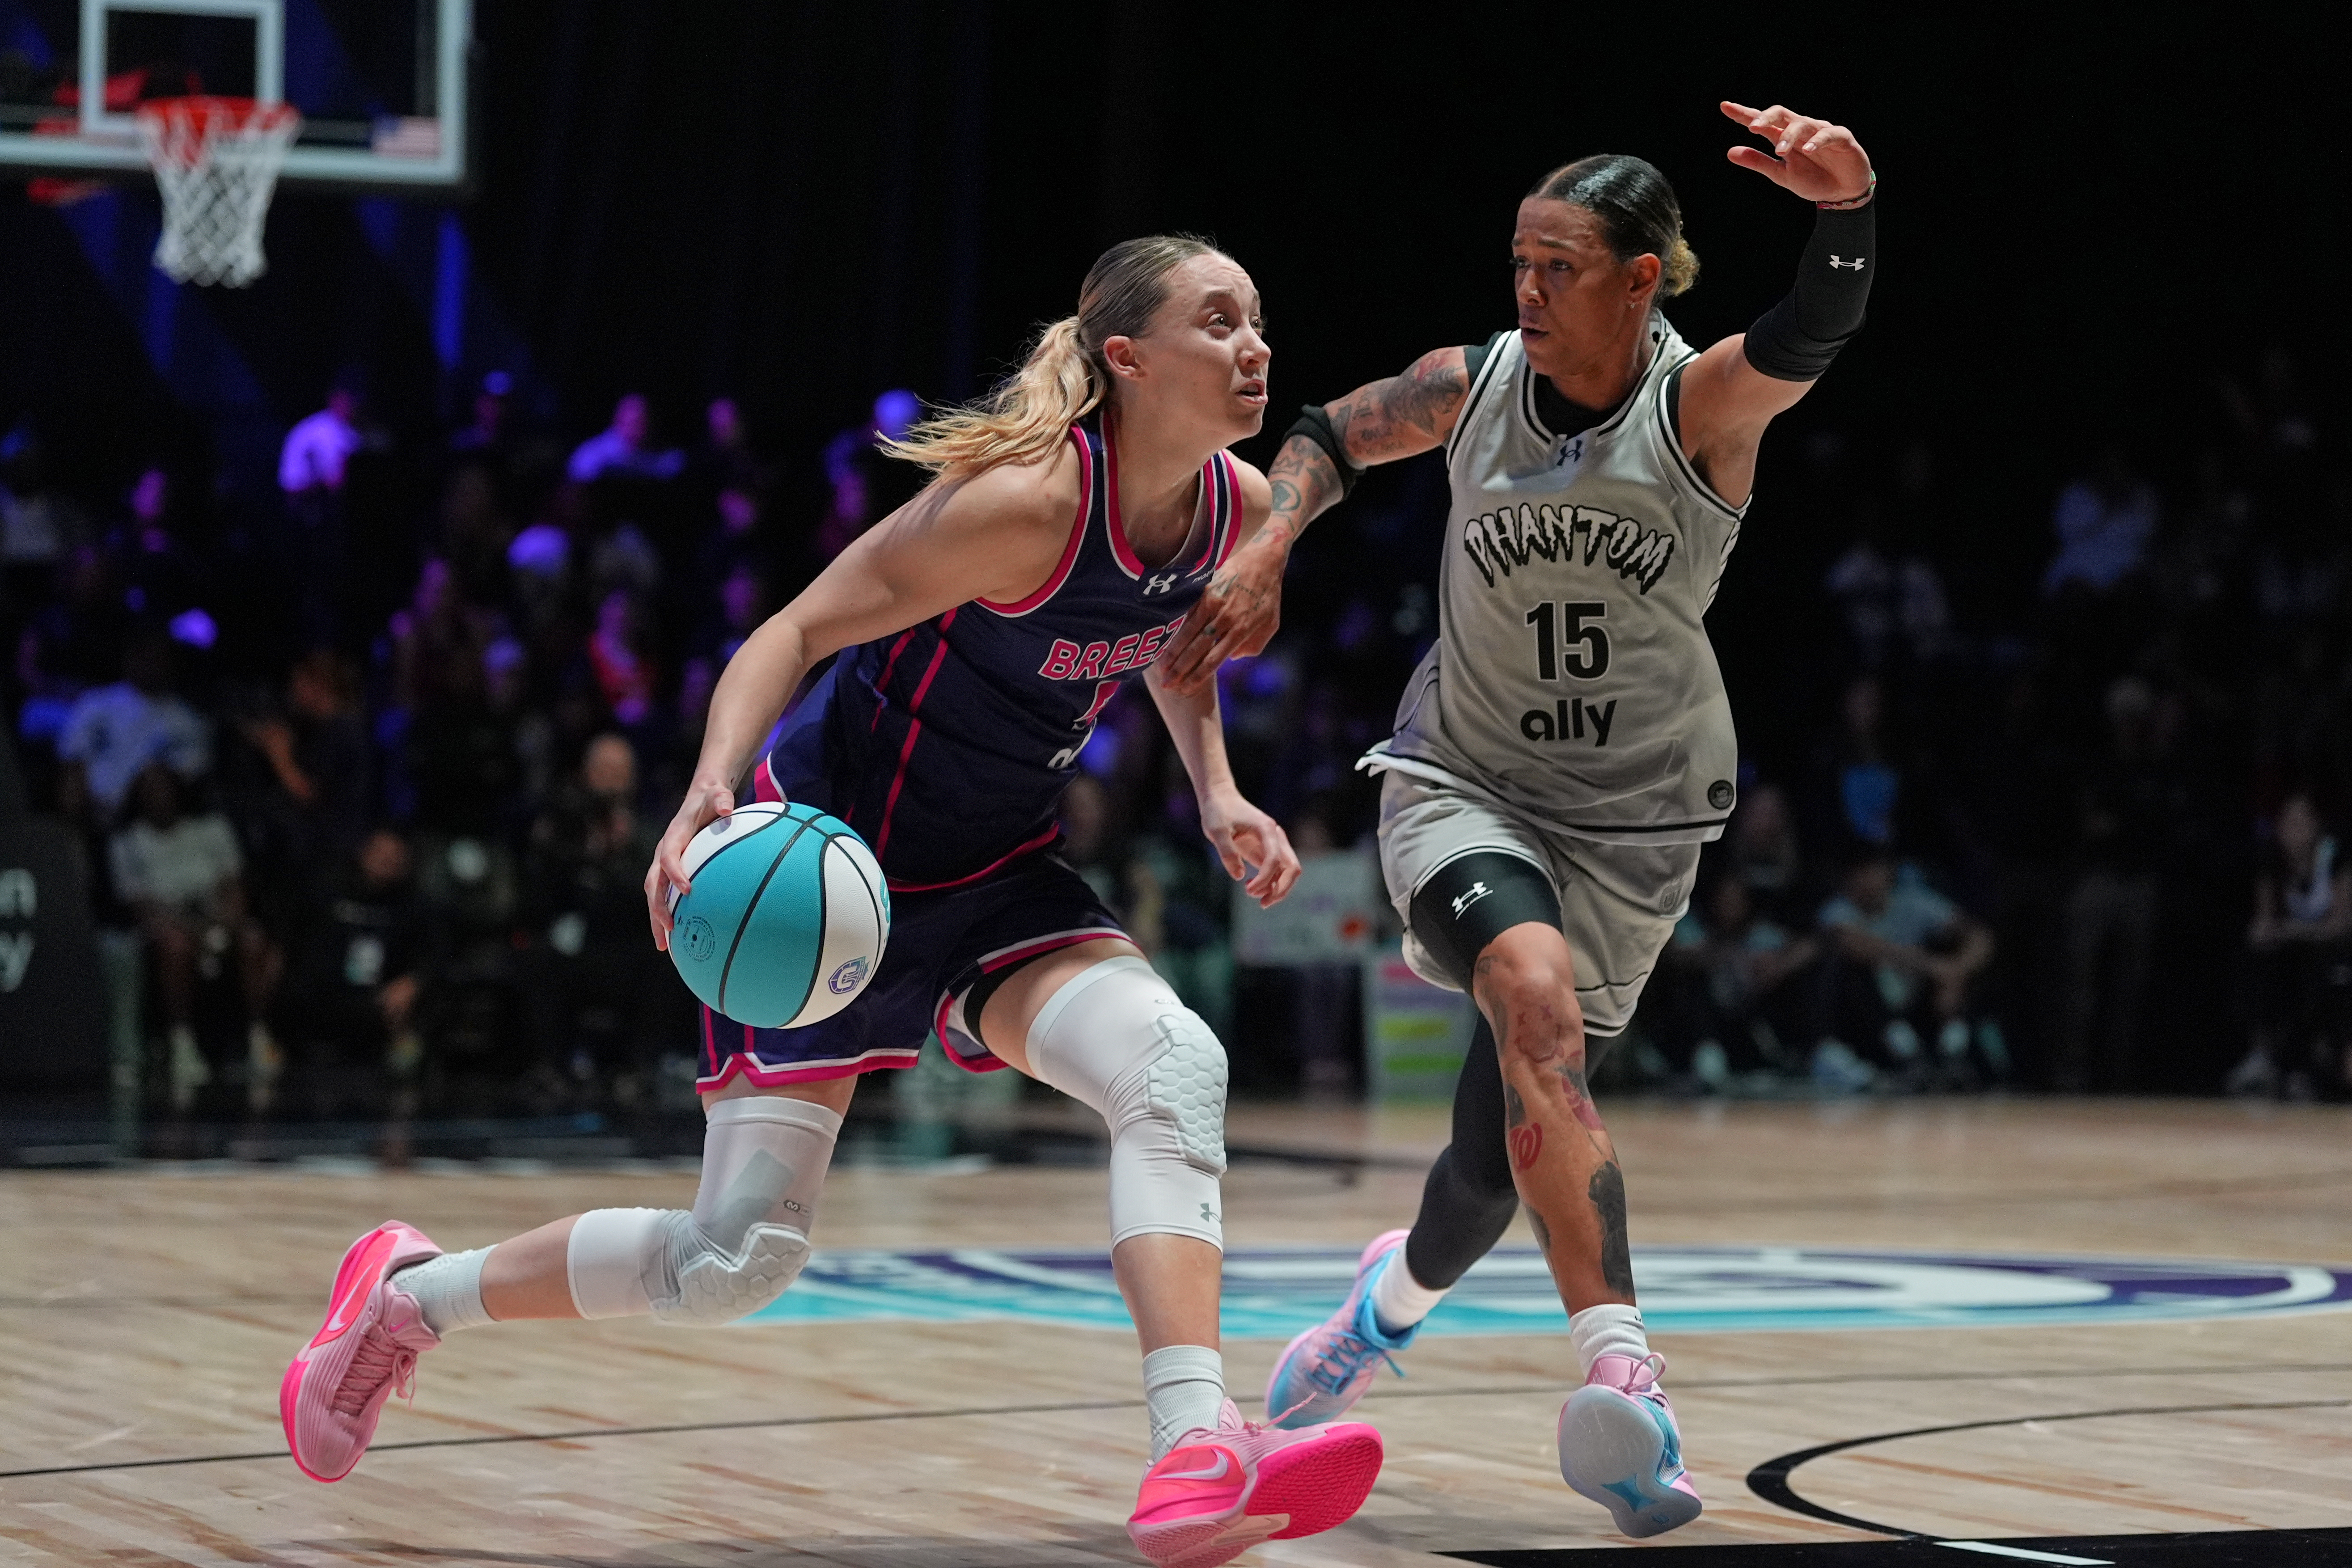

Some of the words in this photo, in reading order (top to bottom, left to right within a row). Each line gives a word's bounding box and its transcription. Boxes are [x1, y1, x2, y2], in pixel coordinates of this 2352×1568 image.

[1464, 503, 1674, 595] PHANTOM
[1037, 613, 1187, 680] BREEZ
[1524, 600, 1612, 682] 15
[1520, 697, 1617, 748] ally
